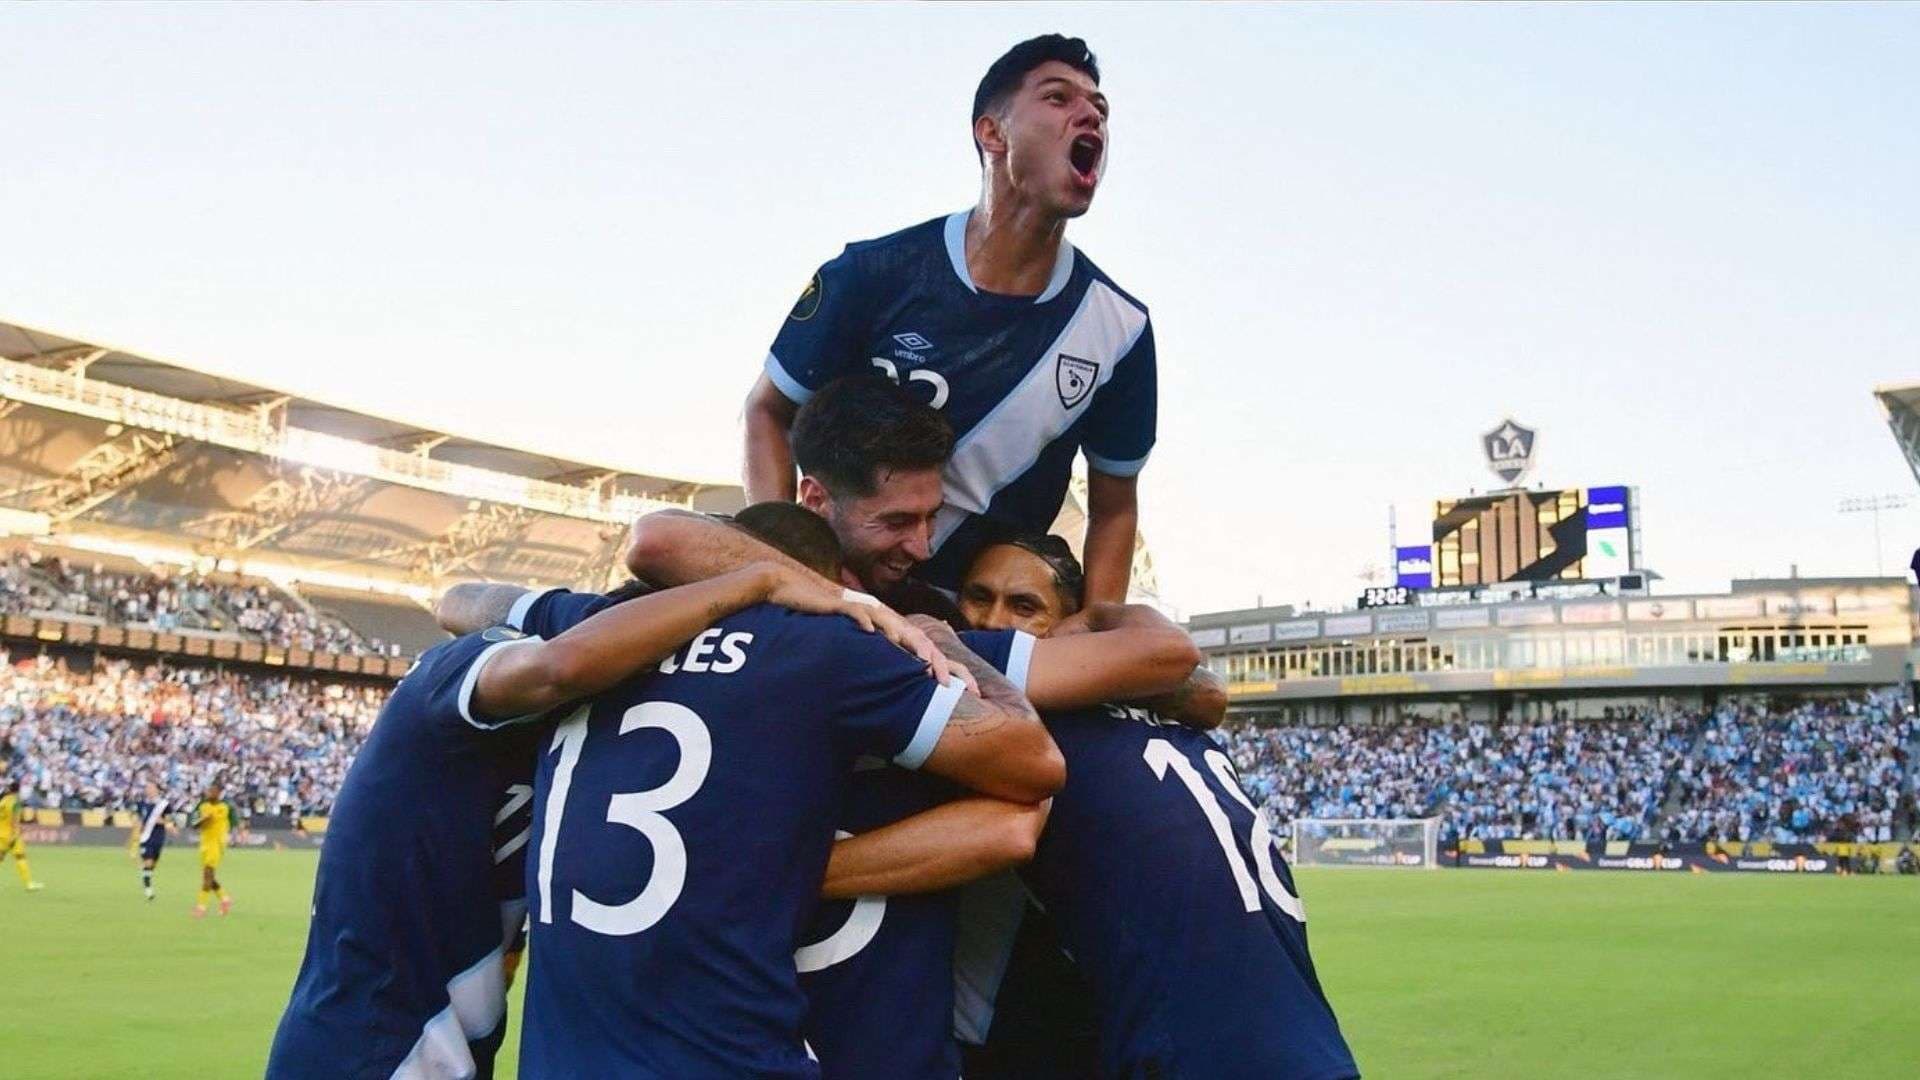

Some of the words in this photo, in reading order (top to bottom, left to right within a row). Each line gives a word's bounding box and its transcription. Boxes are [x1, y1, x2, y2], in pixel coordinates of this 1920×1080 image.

[894, 348, 926, 364] umbro
[1492, 438, 1527, 458] LA
[538, 701, 713, 936] 13
